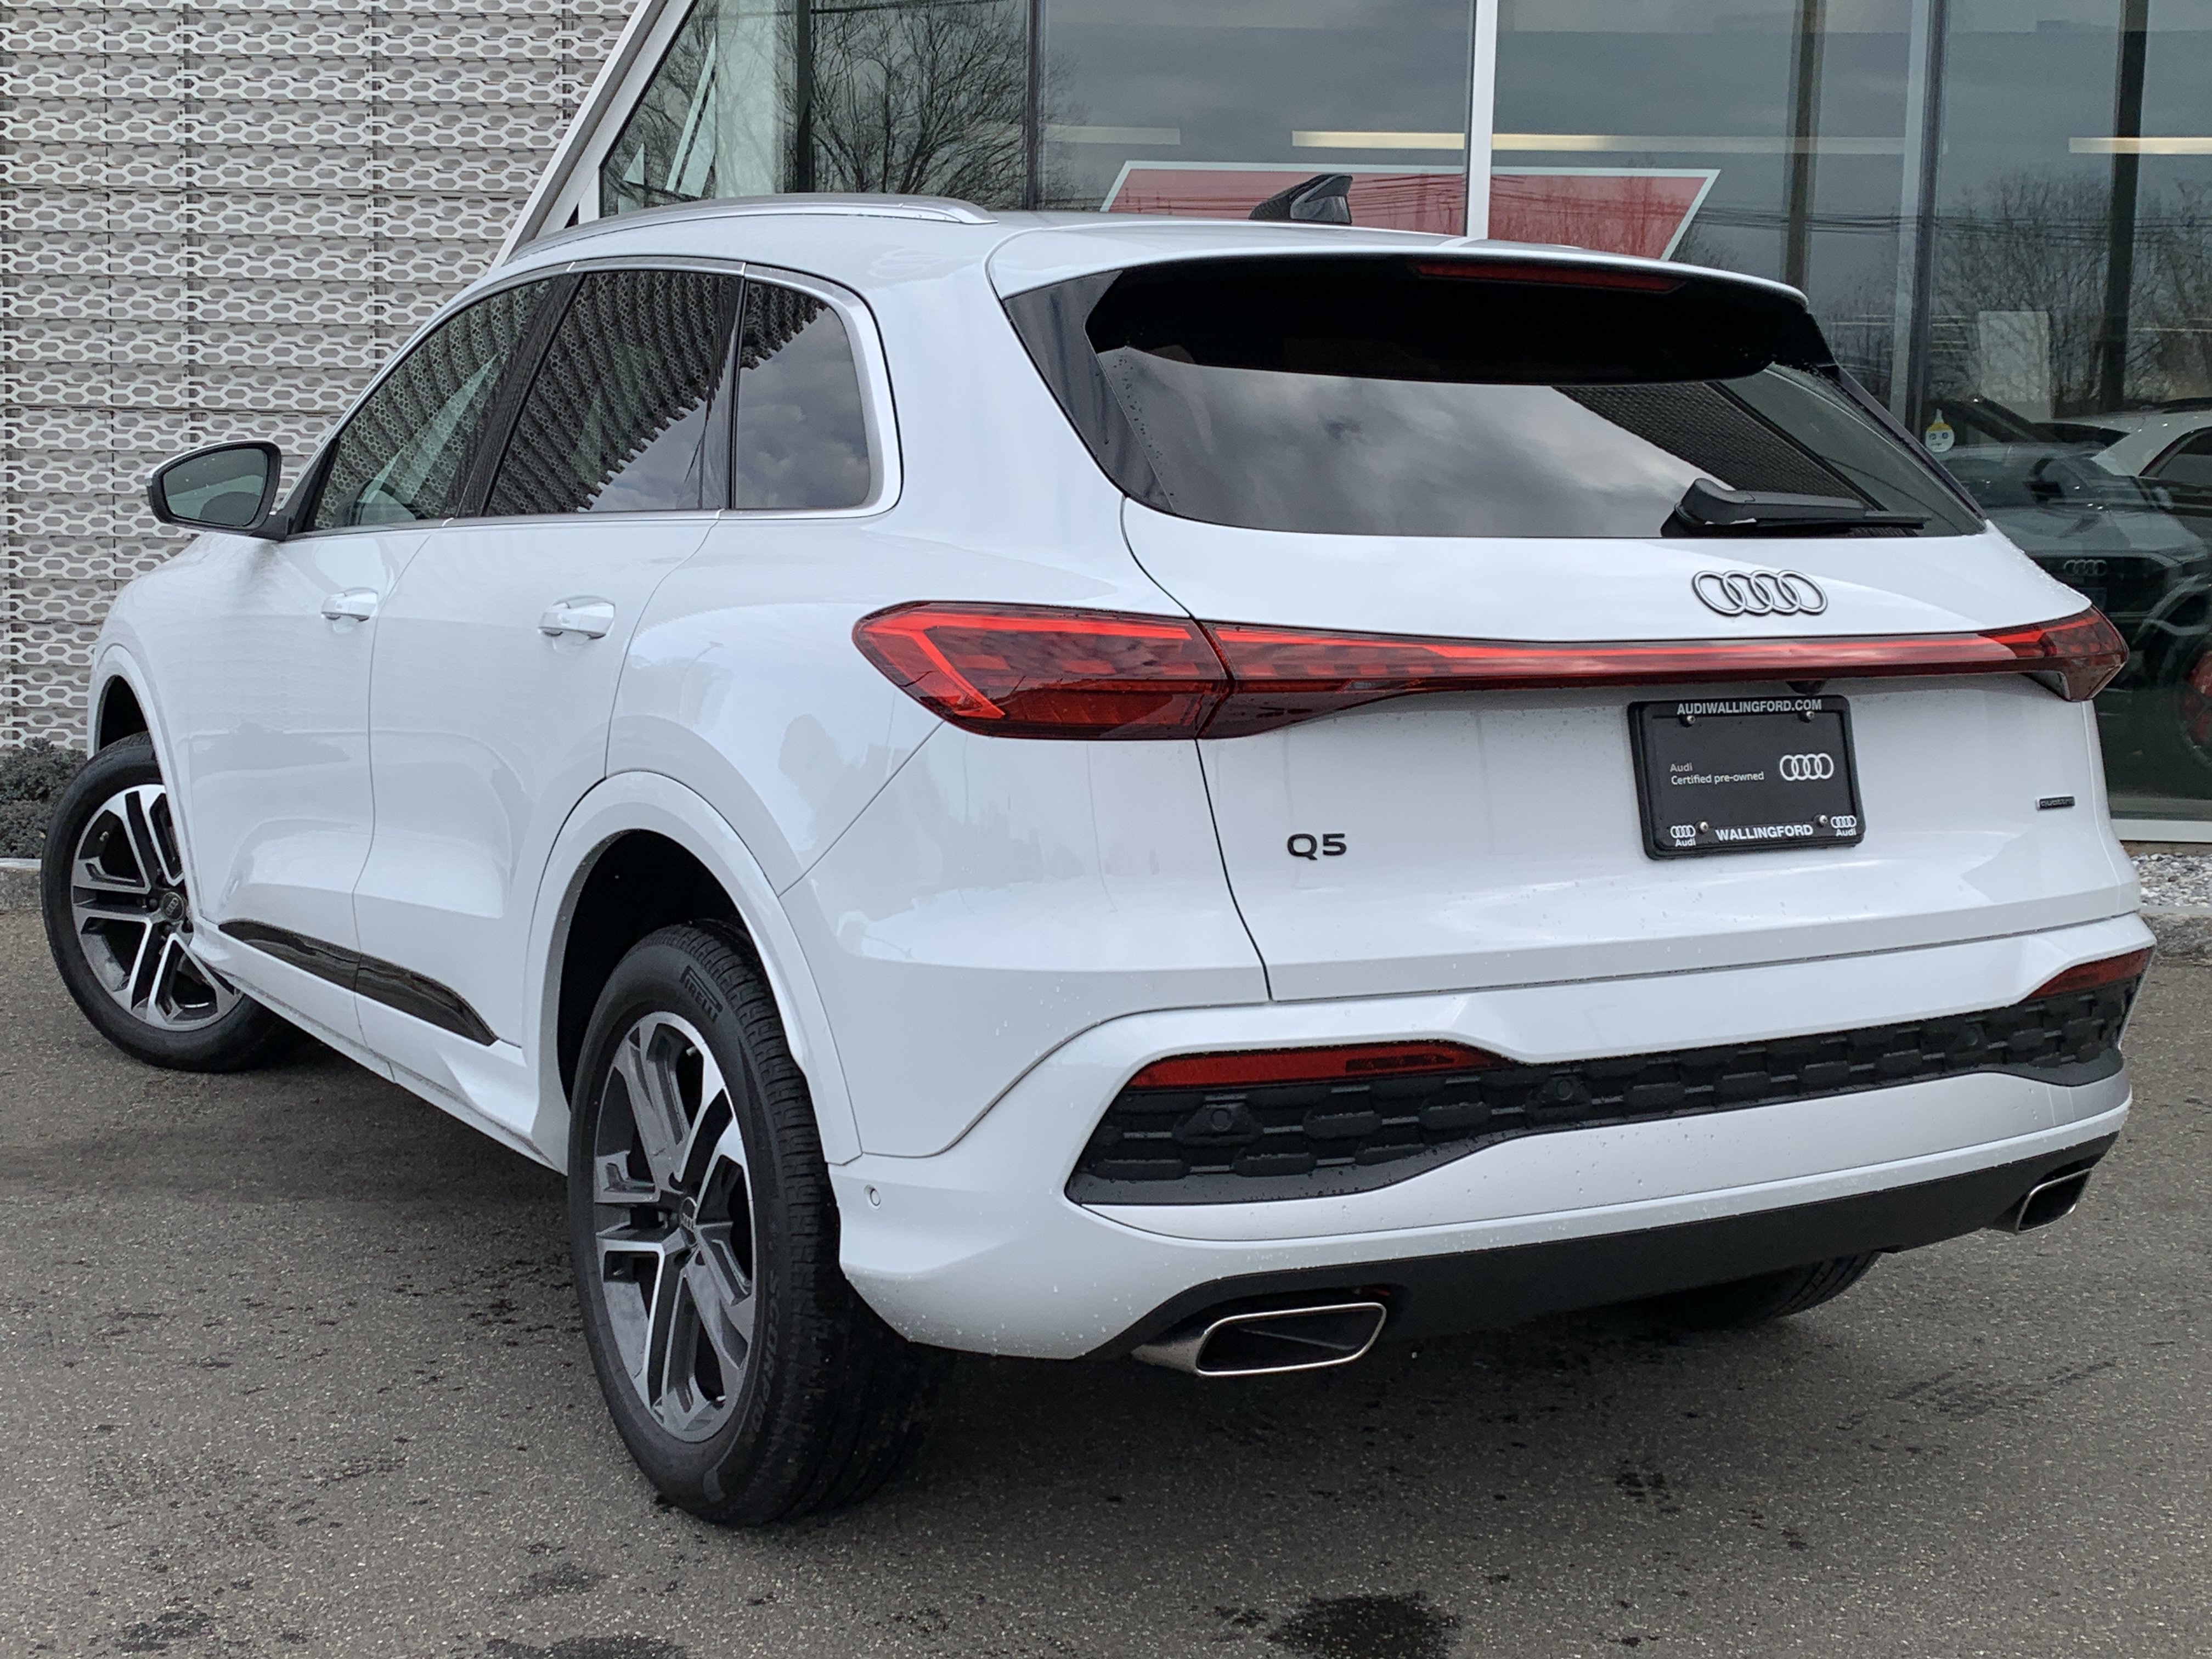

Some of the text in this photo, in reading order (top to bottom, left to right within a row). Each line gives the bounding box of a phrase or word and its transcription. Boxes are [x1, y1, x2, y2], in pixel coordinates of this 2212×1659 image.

[1677, 699, 1822, 714] AUDIWALLINGFORD.COM
[1670, 762, 1693, 772] Audi
[1671, 771, 1764, 785] Certified pre-owned
[1716, 825, 1813, 840] WALLINGFORD
[1836, 828, 1857, 837] Audi
[1287, 833, 1347, 860] Q5
[1675, 838, 1696, 847] Audi
[679, 964, 723, 1024] PIRELLI
